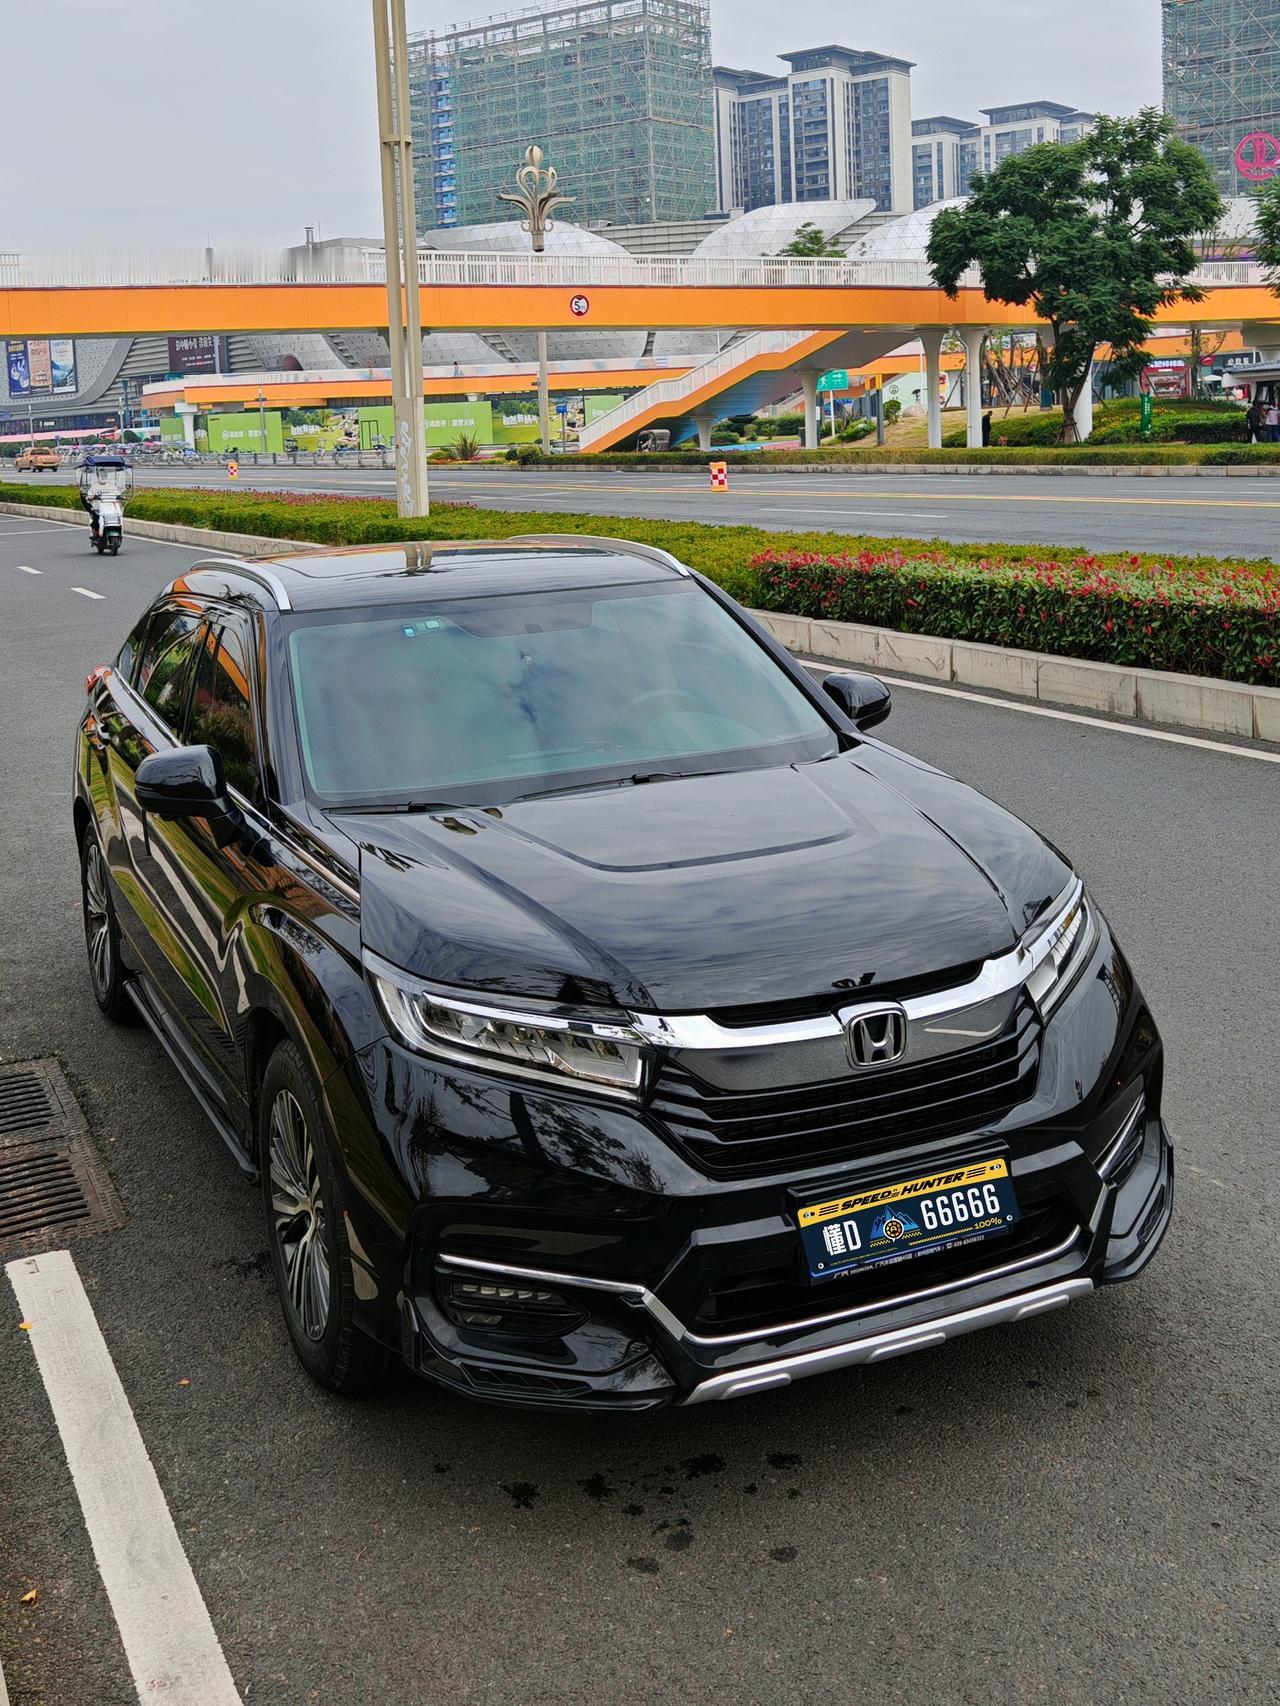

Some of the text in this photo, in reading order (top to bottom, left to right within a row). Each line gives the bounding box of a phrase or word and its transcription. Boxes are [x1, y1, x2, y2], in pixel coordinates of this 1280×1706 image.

[841, 1171, 965, 1211] SPEED HUNTER
[920, 1183, 1000, 1230] 66666
[974, 1217, 1002, 1230] 100%
[850, 1265, 874, 1275] HONDA
